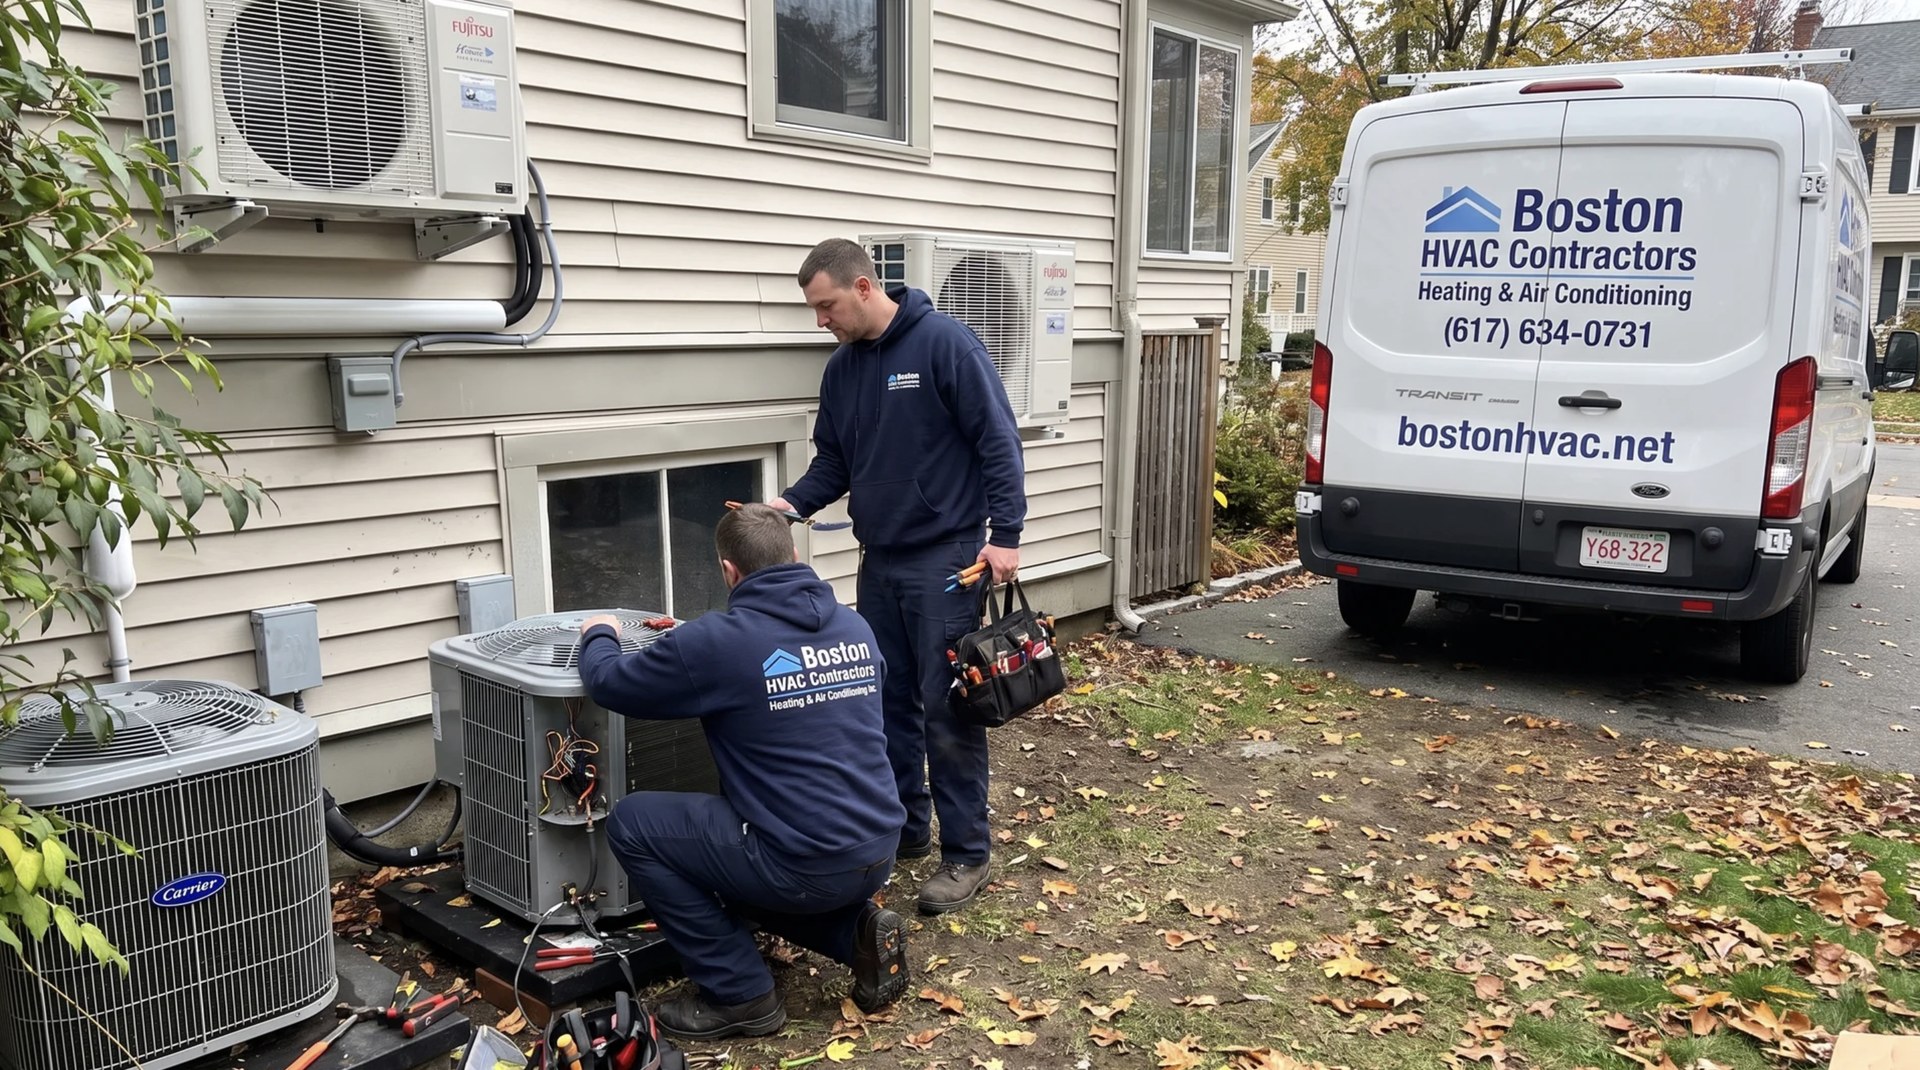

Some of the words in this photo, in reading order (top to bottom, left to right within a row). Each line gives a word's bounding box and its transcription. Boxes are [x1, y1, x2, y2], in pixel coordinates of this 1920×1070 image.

[452, 17, 493, 38] FUJITSU
[1512, 188, 1683, 232] Boston
[1421, 239, 1499, 268] HVAC
[1509, 239, 1697, 271] Contractors
[1418, 281, 1492, 306] Heating
[1499, 282, 1513, 302] &
[1518, 282, 1549, 302] Air
[1555, 283, 1692, 311] Conditioning
[1444, 317, 1510, 348] (617)
[1519, 318, 1652, 348] 634-0731
[1396, 388, 1483, 402] TRANSIT
[1398, 416, 1676, 463] bostonhvac.net
[1586, 537, 1664, 563] Y68-322
[800, 642, 871, 669] Boston
[766, 674, 806, 694] HVAC
[809, 665, 875, 686] Contractors
[769, 697, 805, 711] Heating
[806, 694, 813, 704] &
[815, 692, 826, 702] Air
[827, 687, 867, 700] Conditioning
[163, 879, 218, 901] Carrier
